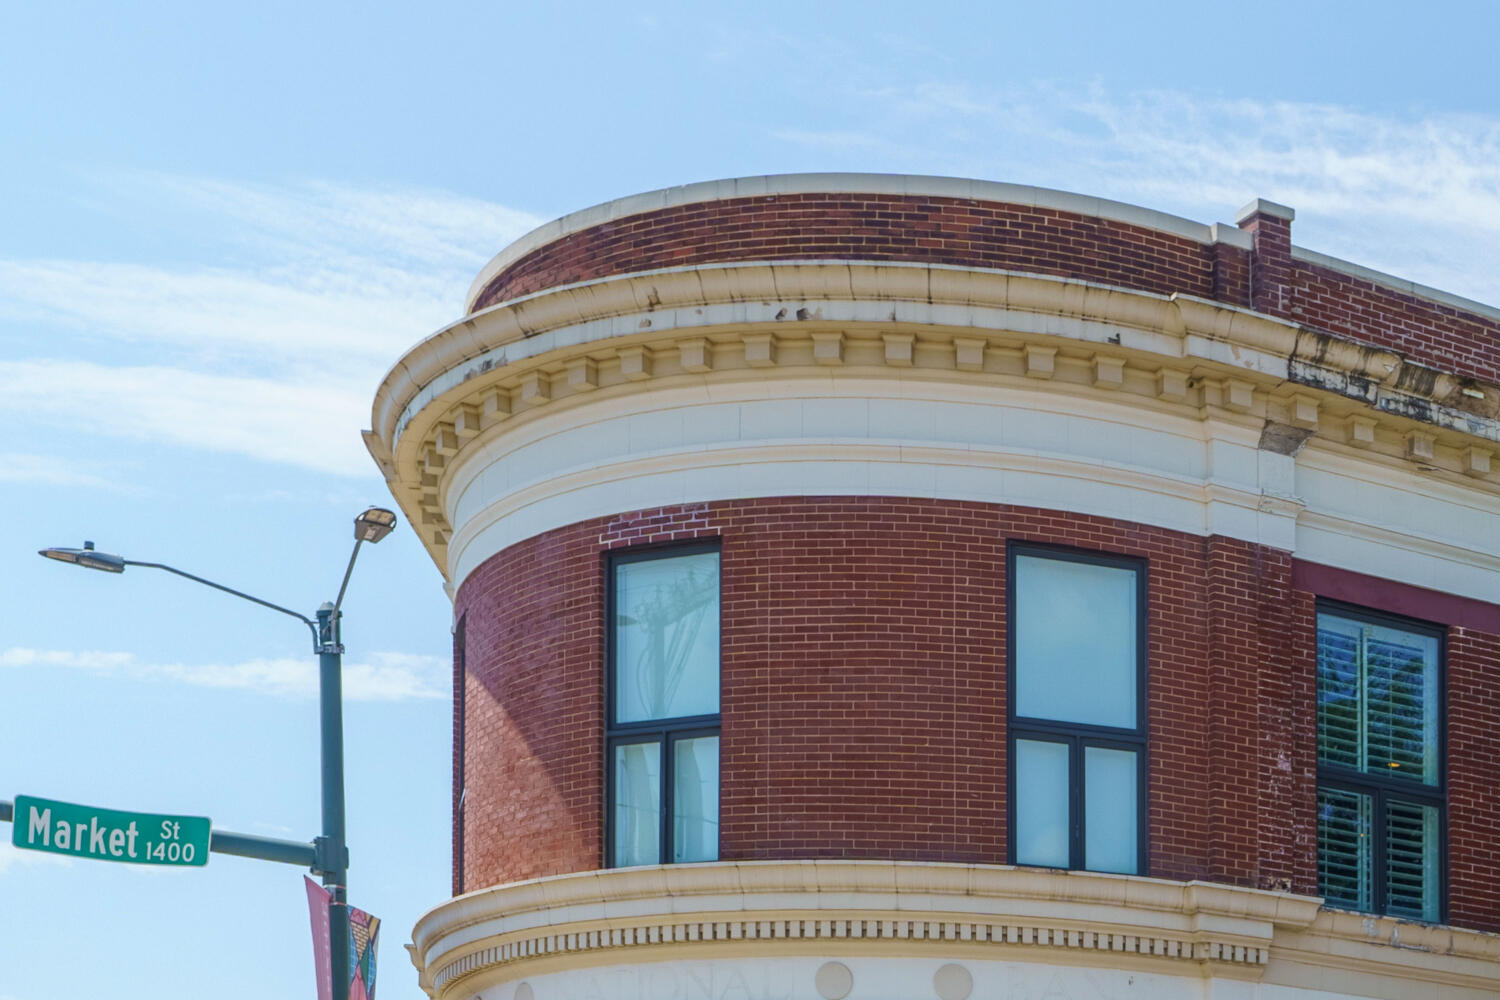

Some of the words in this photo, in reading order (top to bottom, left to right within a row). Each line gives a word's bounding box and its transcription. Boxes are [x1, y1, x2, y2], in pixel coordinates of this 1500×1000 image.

[27, 806, 138, 859] Market
[160, 820, 181, 841] St
[146, 841, 195, 863] 1400
